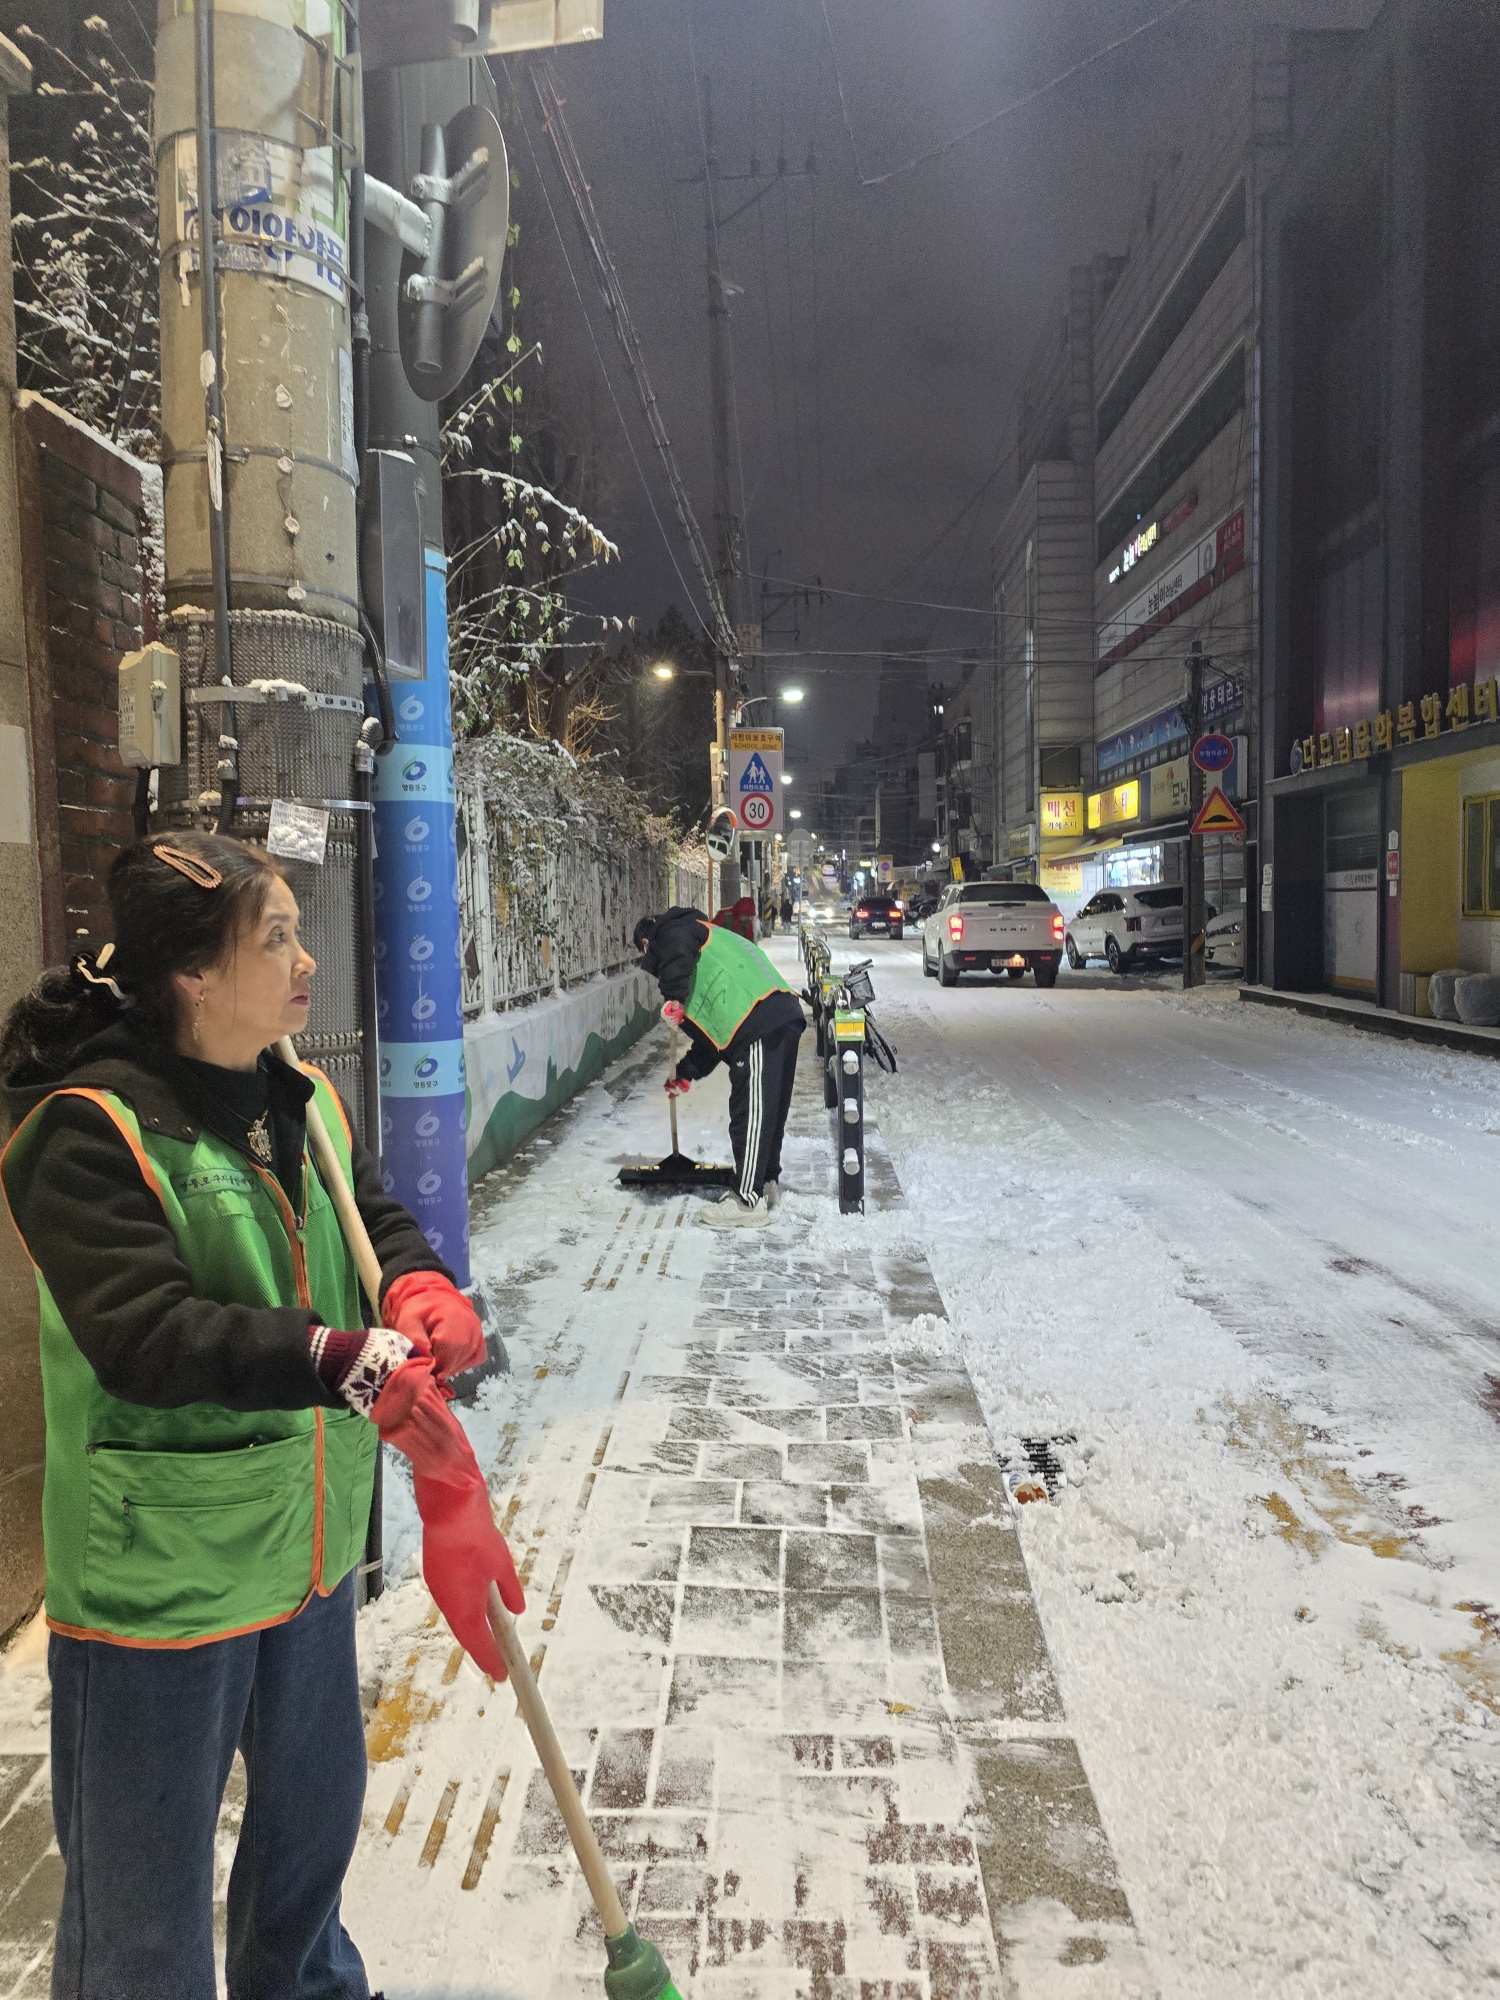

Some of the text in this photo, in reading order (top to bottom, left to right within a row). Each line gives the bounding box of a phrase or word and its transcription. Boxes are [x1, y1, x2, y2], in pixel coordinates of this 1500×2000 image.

[731, 733, 780, 742] 어린이보호구역
[402, 783, 427, 793] 영등포구
[749, 802, 765, 819] 30
[414, 1080, 439, 1089] 영등포구
